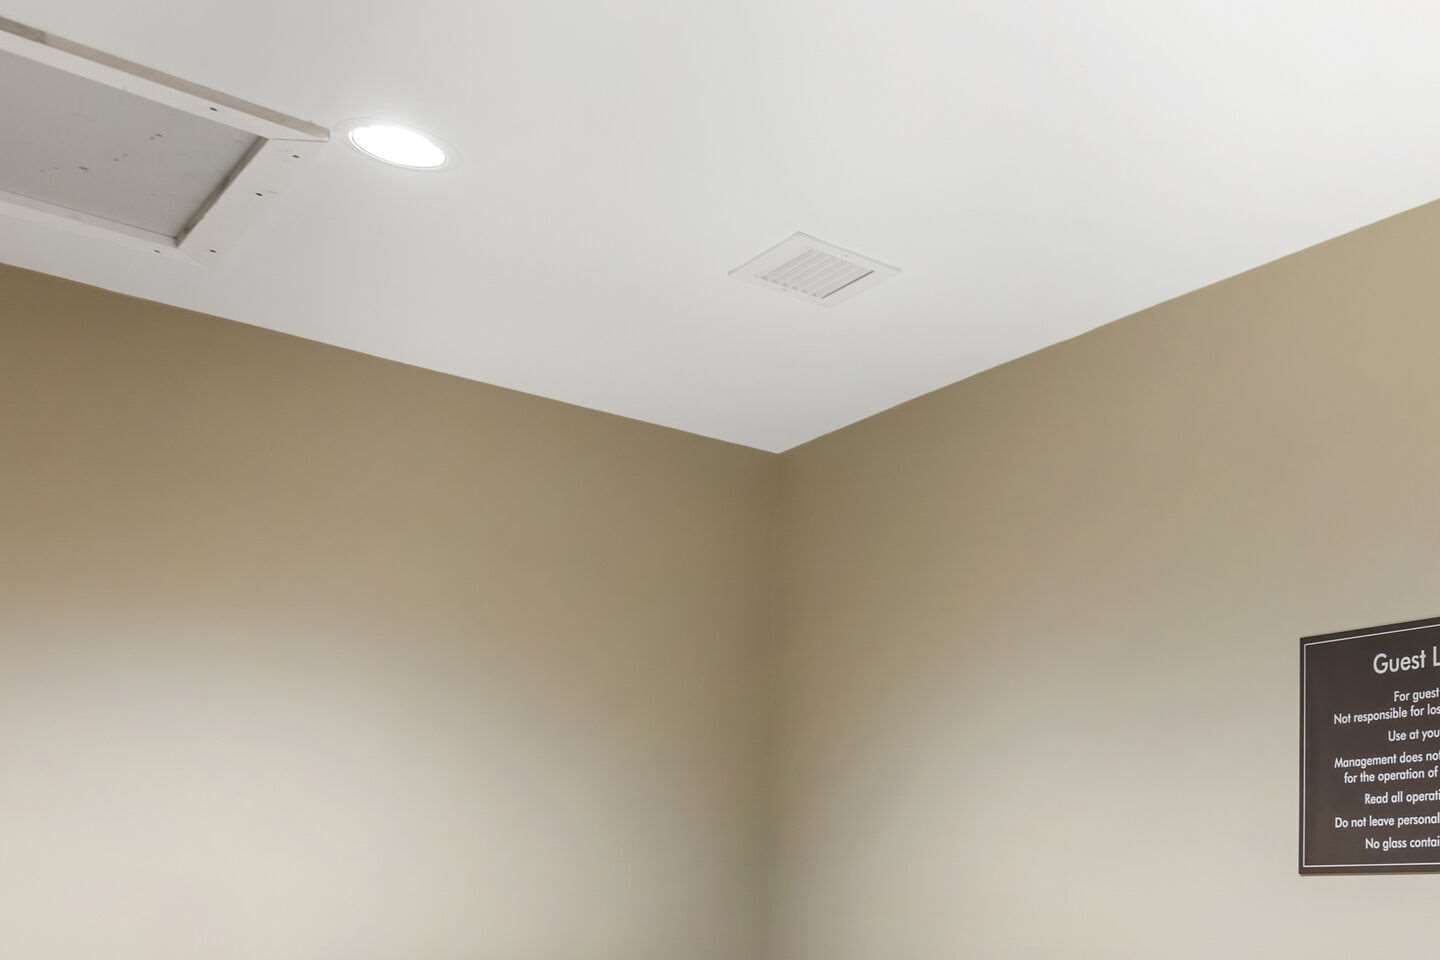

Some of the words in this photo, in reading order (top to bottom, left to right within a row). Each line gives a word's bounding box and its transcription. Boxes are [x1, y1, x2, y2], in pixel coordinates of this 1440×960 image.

[1373, 650, 1426, 674] Guest
[1394, 691, 1410, 702] For
[1413, 688, 1439, 702] guest
[1334, 714, 1350, 724] Not
[1354, 708, 1407, 724] responsible
[1410, 706, 1424, 716] for
[1388, 730, 1407, 742] Use
[1409, 729, 1420, 740] at
[1334, 754, 1396, 768] Management
[1400, 752, 1423, 763] does
[1344, 772, 1357, 783] for
[1360, 771, 1375, 782] the
[1378, 768, 1424, 783] operation
[1428, 766, 1439, 778] of
[1364, 792, 1388, 804] Read
[1391, 791, 1403, 803] all
[1335, 817, 1348, 828] Do
[1351, 817, 1366, 827] not
[1369, 816, 1394, 826] leave
[1398, 812, 1440, 828] personal
[1365, 838, 1380, 849] No
[1383, 837, 1407, 851] glass
